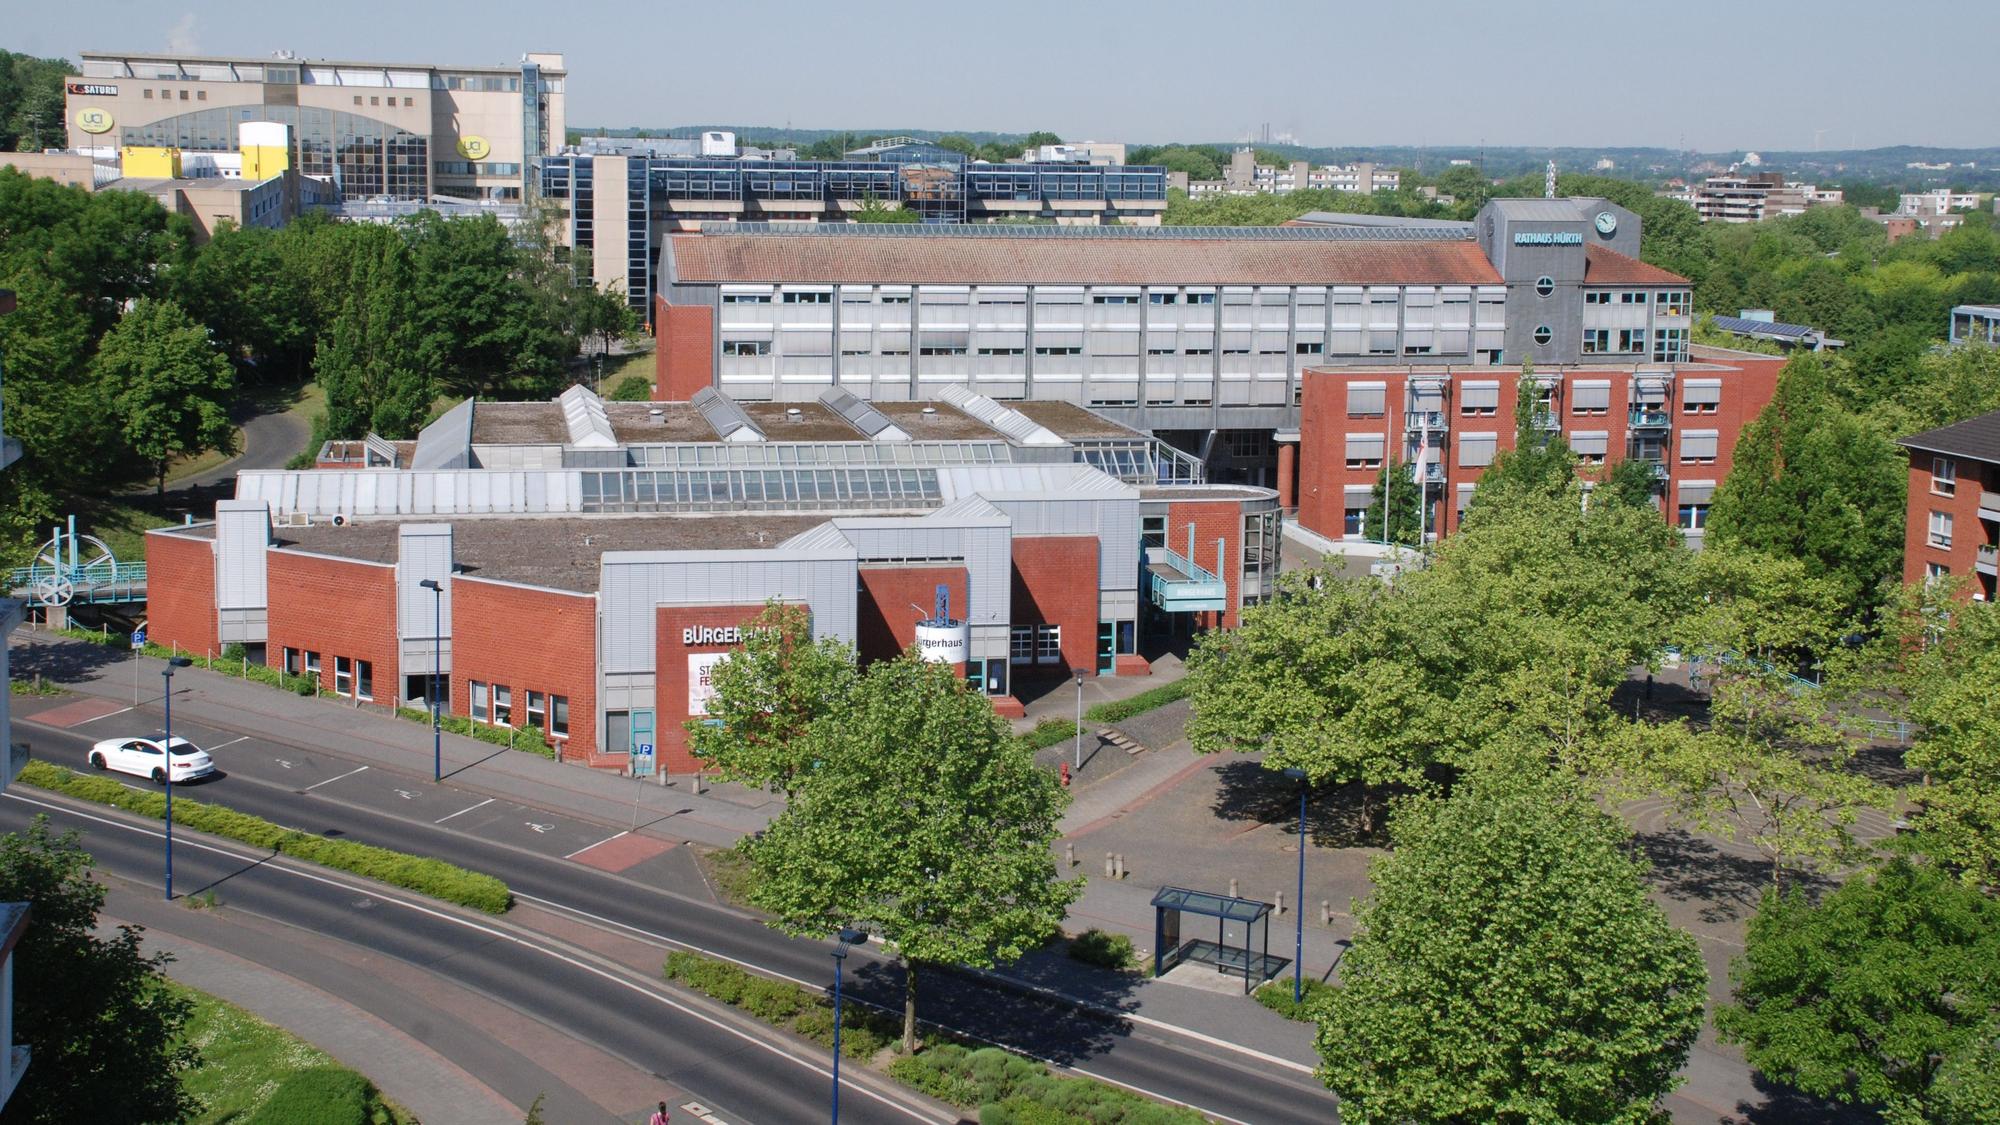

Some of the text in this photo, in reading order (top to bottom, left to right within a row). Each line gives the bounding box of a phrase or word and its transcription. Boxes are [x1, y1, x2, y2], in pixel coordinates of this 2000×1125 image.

[84, 85, 117, 95] SATURN
[84, 113, 103, 124] UCI
[464, 141, 480, 151] UCI
[1514, 231, 1582, 243] RATHAUS HÜRTH
[134, 633, 141, 642] P
[642, 745, 650, 754] P
